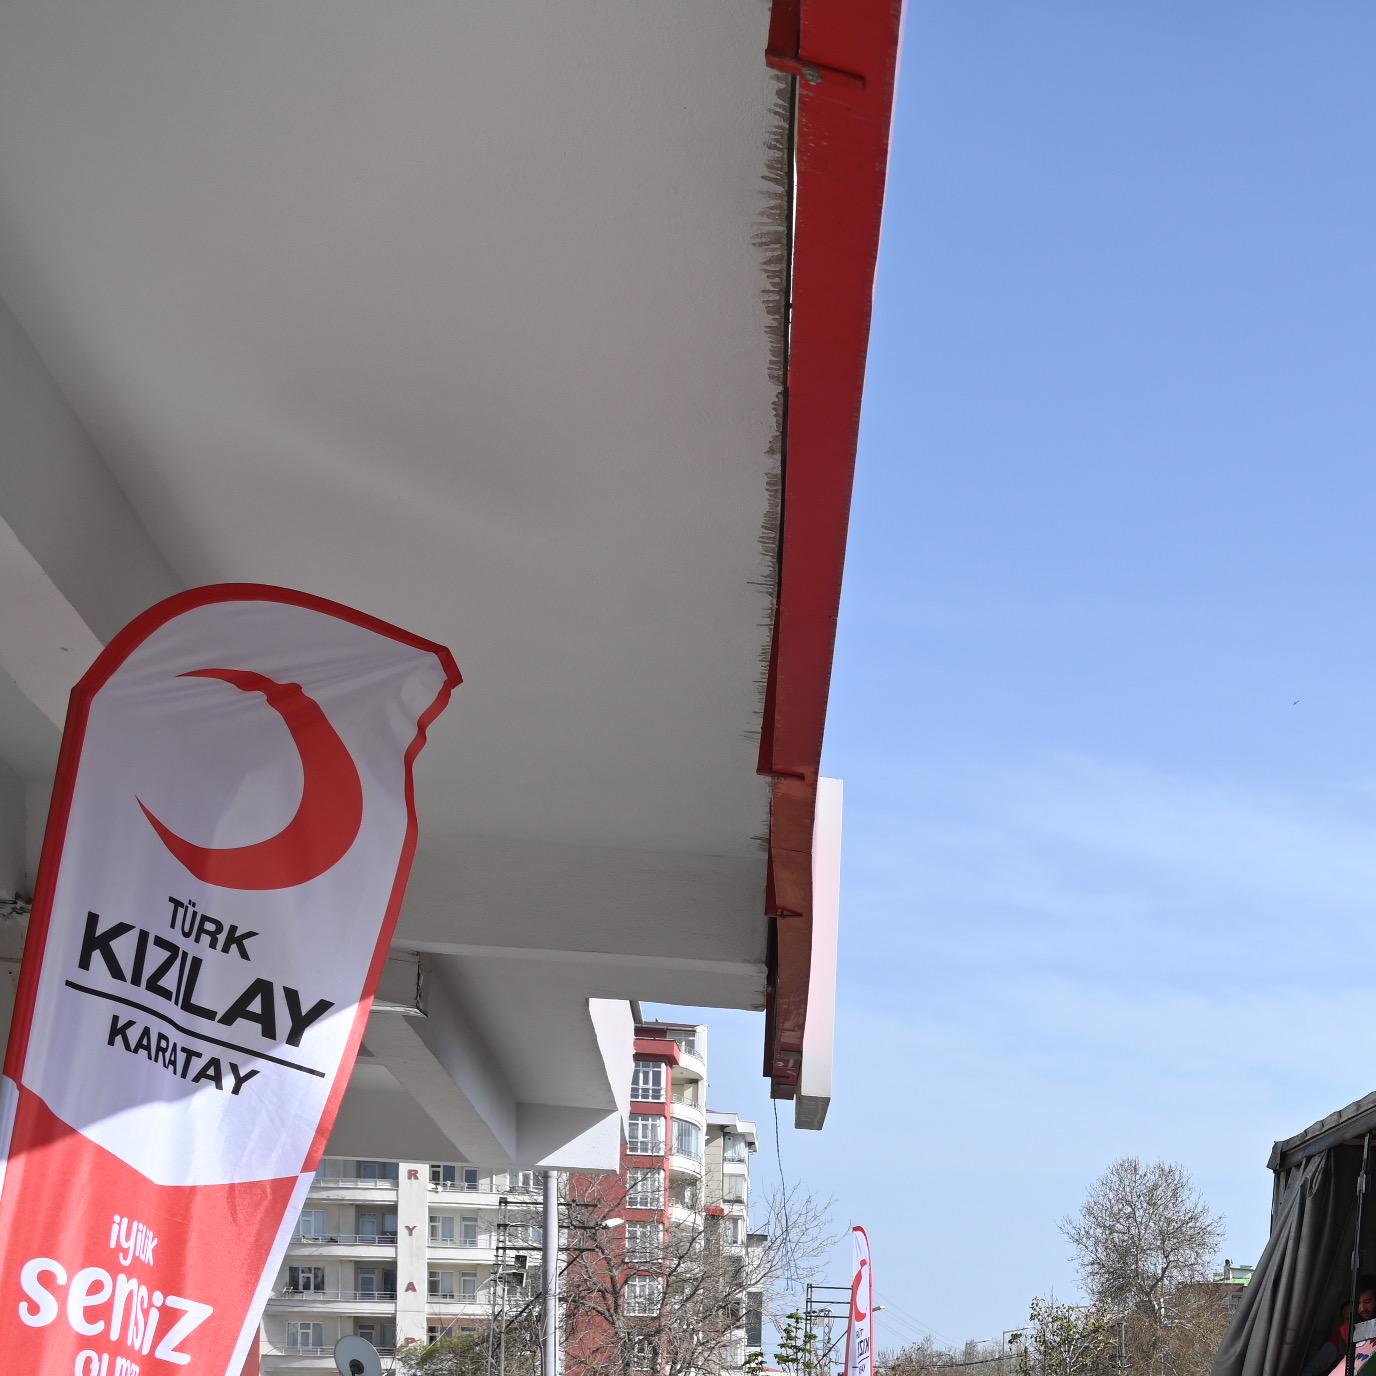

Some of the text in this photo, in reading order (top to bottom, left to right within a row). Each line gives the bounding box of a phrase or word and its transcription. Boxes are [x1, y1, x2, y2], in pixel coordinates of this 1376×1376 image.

[168, 895, 260, 962] TÜRK
[78, 911, 335, 1048] KIZILAY
[107, 1014, 260, 1096] KARATAY
[109, 1213, 158, 1267] iyilik
[18, 1257, 214, 1366] sensiz
